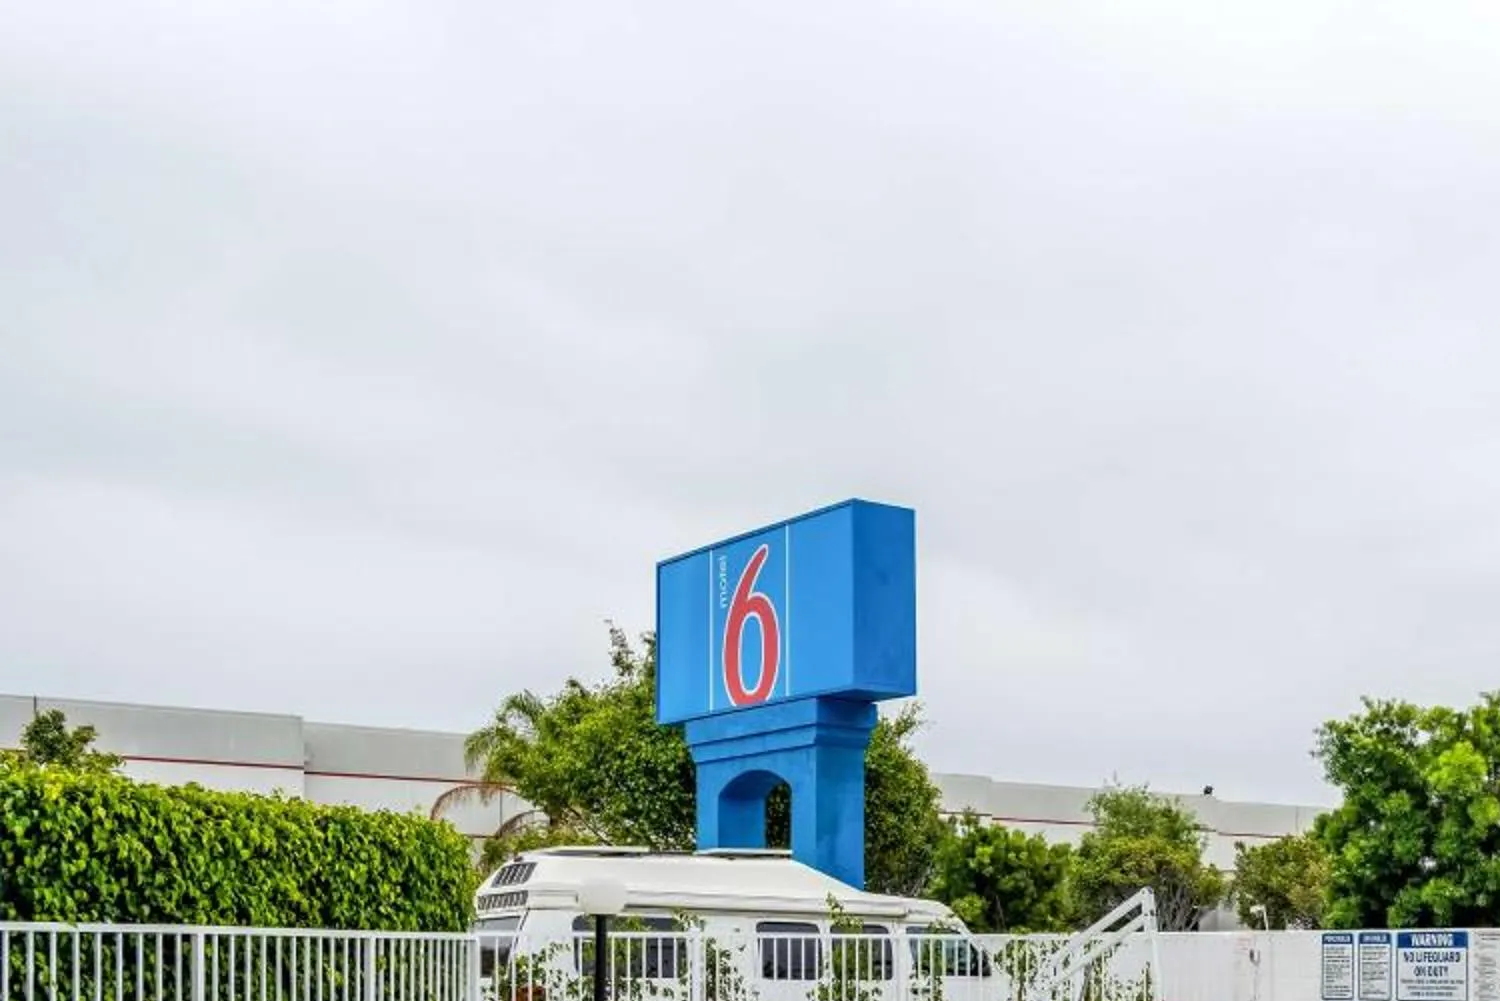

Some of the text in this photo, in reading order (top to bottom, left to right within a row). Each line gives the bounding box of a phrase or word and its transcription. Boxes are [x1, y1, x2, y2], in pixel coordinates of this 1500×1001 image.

[722, 543, 780, 706] 6
[1411, 933, 1454, 947] WARNING
[1403, 951, 1461, 963] NO LIFEGUARD
